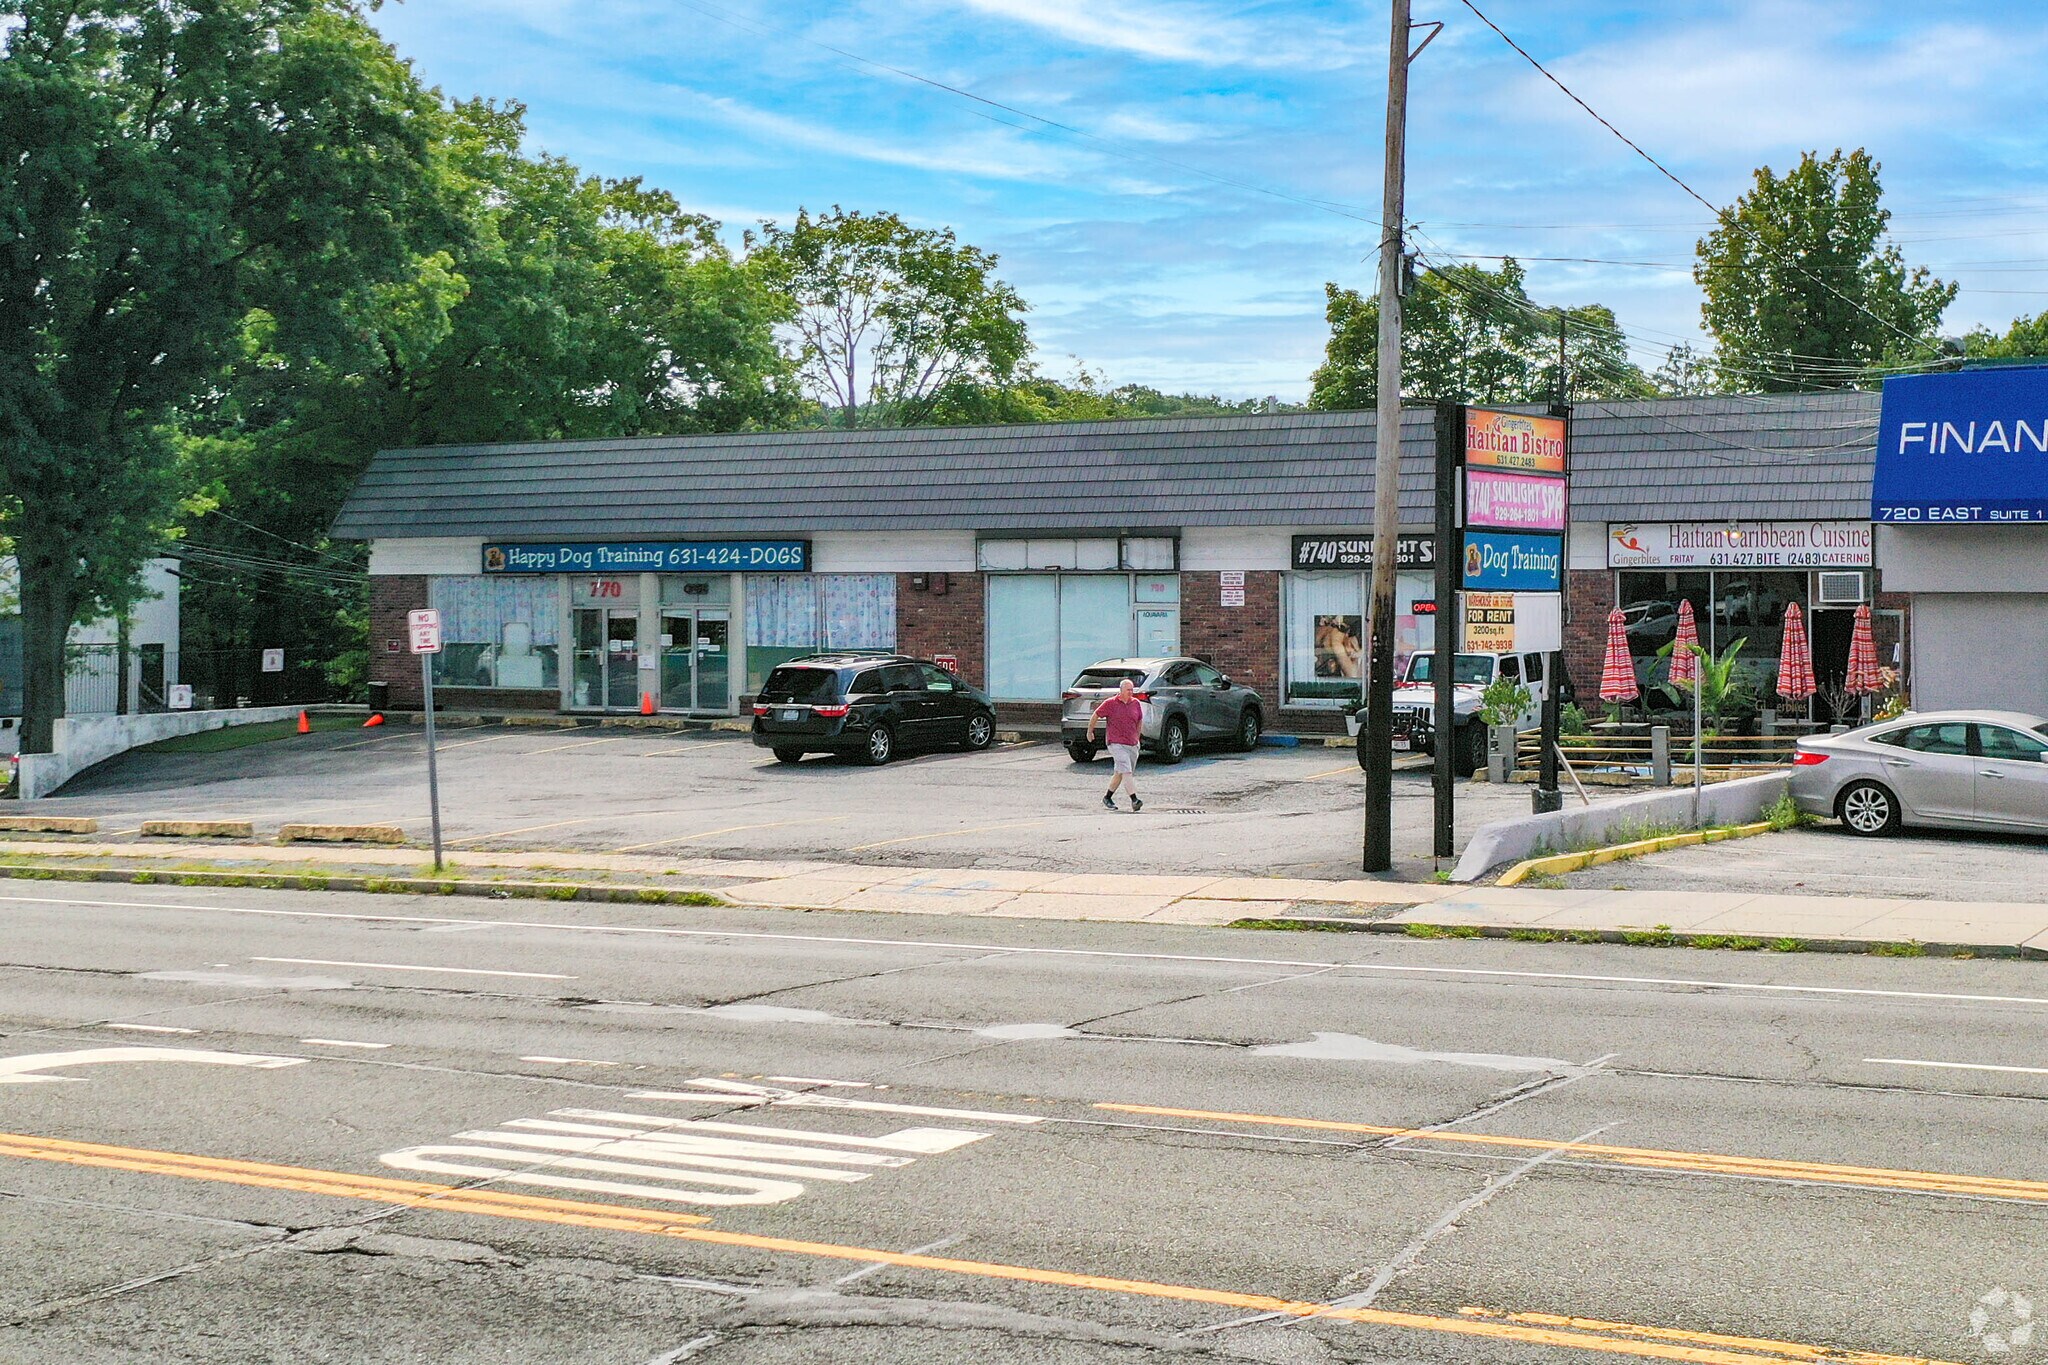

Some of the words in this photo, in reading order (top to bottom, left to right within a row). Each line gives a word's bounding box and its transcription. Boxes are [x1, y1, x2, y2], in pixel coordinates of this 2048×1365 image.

[1467, 424, 1518, 453] Haitian
[1521, 429, 1564, 458] Bistro
[1899, 419, 2048, 454] FINAN
[1492, 480, 1540, 505] SUNLIGHT
[1541, 485, 1563, 522] SPA
[1494, 506, 1539, 522] 929-264-1801
[1880, 508, 1921, 520] 720
[1928, 507, 1982, 520] EAST
[1989, 511, 2029, 520] SUITE
[2036, 511, 2043, 520] 1
[1668, 524, 1723, 549] Haitian
[1810, 522, 1870, 548] Cuisine
[508, 548, 555, 568] Happy
[560, 548, 592, 568] Dog
[597, 547, 664, 567] Training
[668, 547, 802, 564] 631-424-DOGS
[1299, 541, 1338, 564] #740
[1483, 544, 1509, 577] Dog
[1511, 544, 1558, 578] Training
[1613, 552, 1661, 566] Gingerbites
[1669, 554, 1695, 564] FRITAY
[1709, 553, 1780, 565] 631.427.BITE
[1787, 552, 1820, 565] (2483)
[1821, 554, 1870, 563] CATERING
[590, 581, 622, 597] 770
[418, 614, 430, 622] NO
[1467, 610, 1484, 622] FOR
[1486, 610, 1513, 622] RENT
